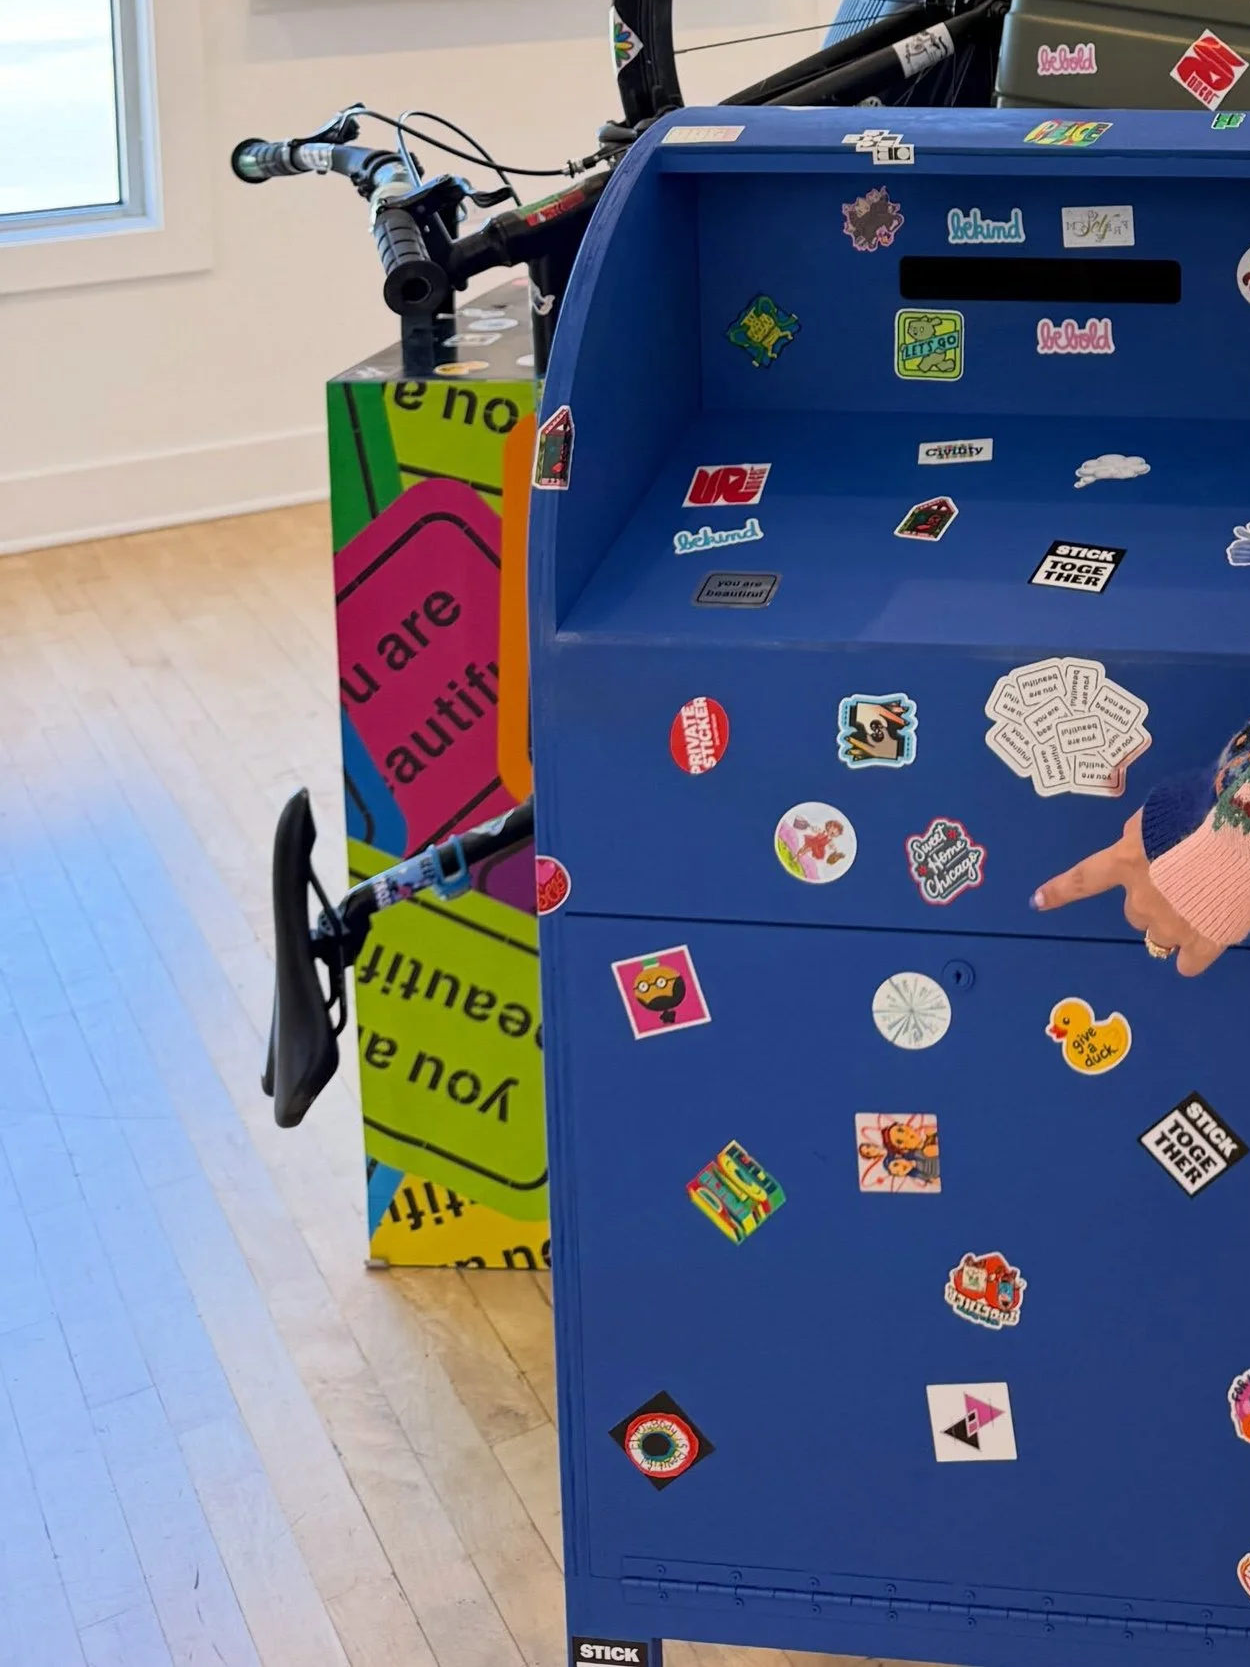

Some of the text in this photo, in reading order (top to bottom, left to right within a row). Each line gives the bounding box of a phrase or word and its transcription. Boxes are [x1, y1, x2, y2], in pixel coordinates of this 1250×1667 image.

[937, 335, 957, 350] GO
[1050, 560, 1107, 576] TOGE
[1056, 545, 1116, 561] STICK
[705, 589, 764, 598] beautiful
[717, 579, 740, 588] you
[1044, 570, 1100, 586] THER
[376, 590, 461, 670] are
[681, 705, 702, 774] PRIVATE
[693, 697, 717, 769] STICKER
[913, 825, 947, 862] Sweet
[928, 840, 965, 874] Home
[926, 851, 979, 897] Chicago
[357, 944, 542, 1051] eautif
[1072, 1027, 1096, 1055] give
[1085, 1043, 1118, 1067] duck
[1087, 1043, 1097, 1053] a
[408, 1051, 519, 1122] you
[1168, 1119, 1217, 1174] TOGE
[1186, 1101, 1238, 1158] STICK
[1154, 1130, 1202, 1185] THER
[580, 1644, 639, 1662] STICK
